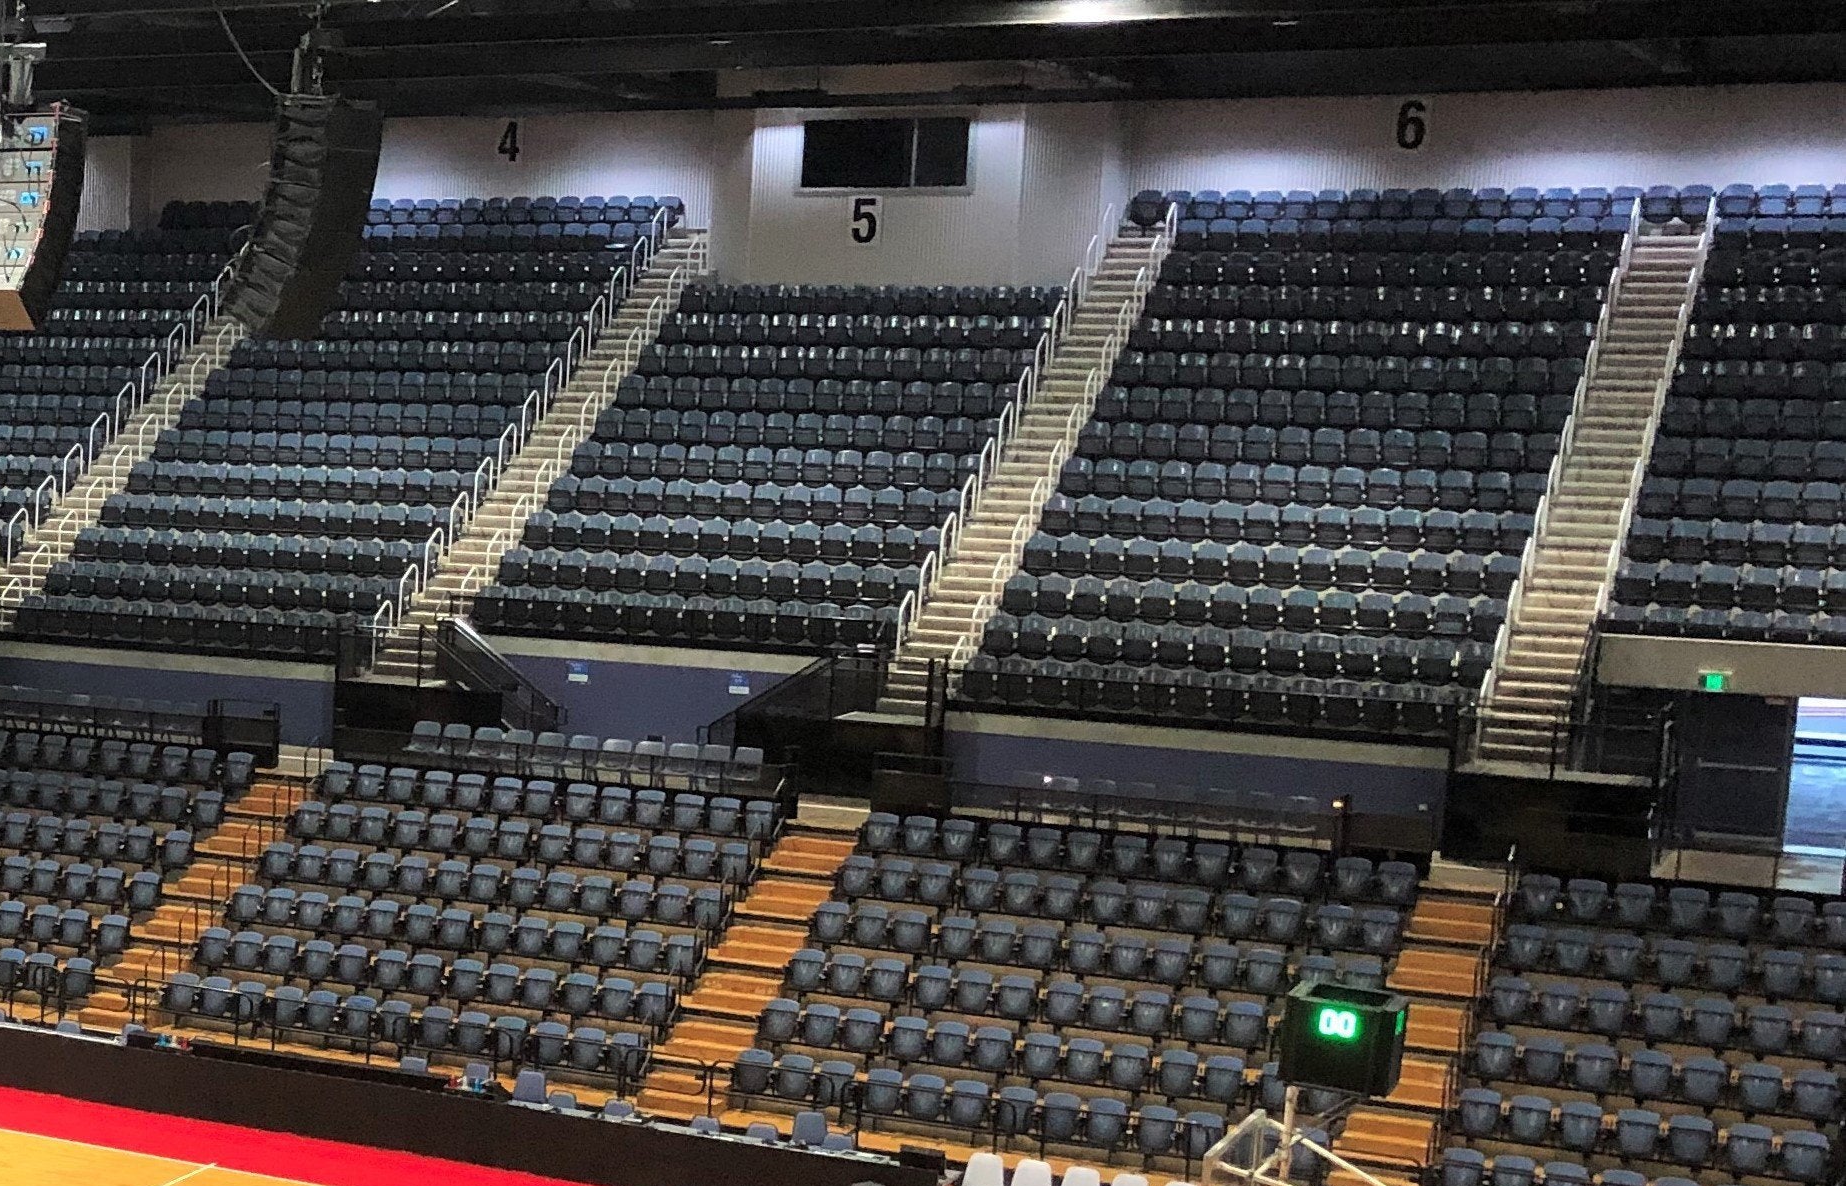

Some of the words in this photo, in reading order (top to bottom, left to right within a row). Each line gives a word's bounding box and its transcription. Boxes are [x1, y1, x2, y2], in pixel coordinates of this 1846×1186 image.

[497, 121, 520, 162] 4
[1397, 100, 1426, 149] 6
[851, 198, 876, 243] 5
[1318, 1008, 1357, 1039] 00
